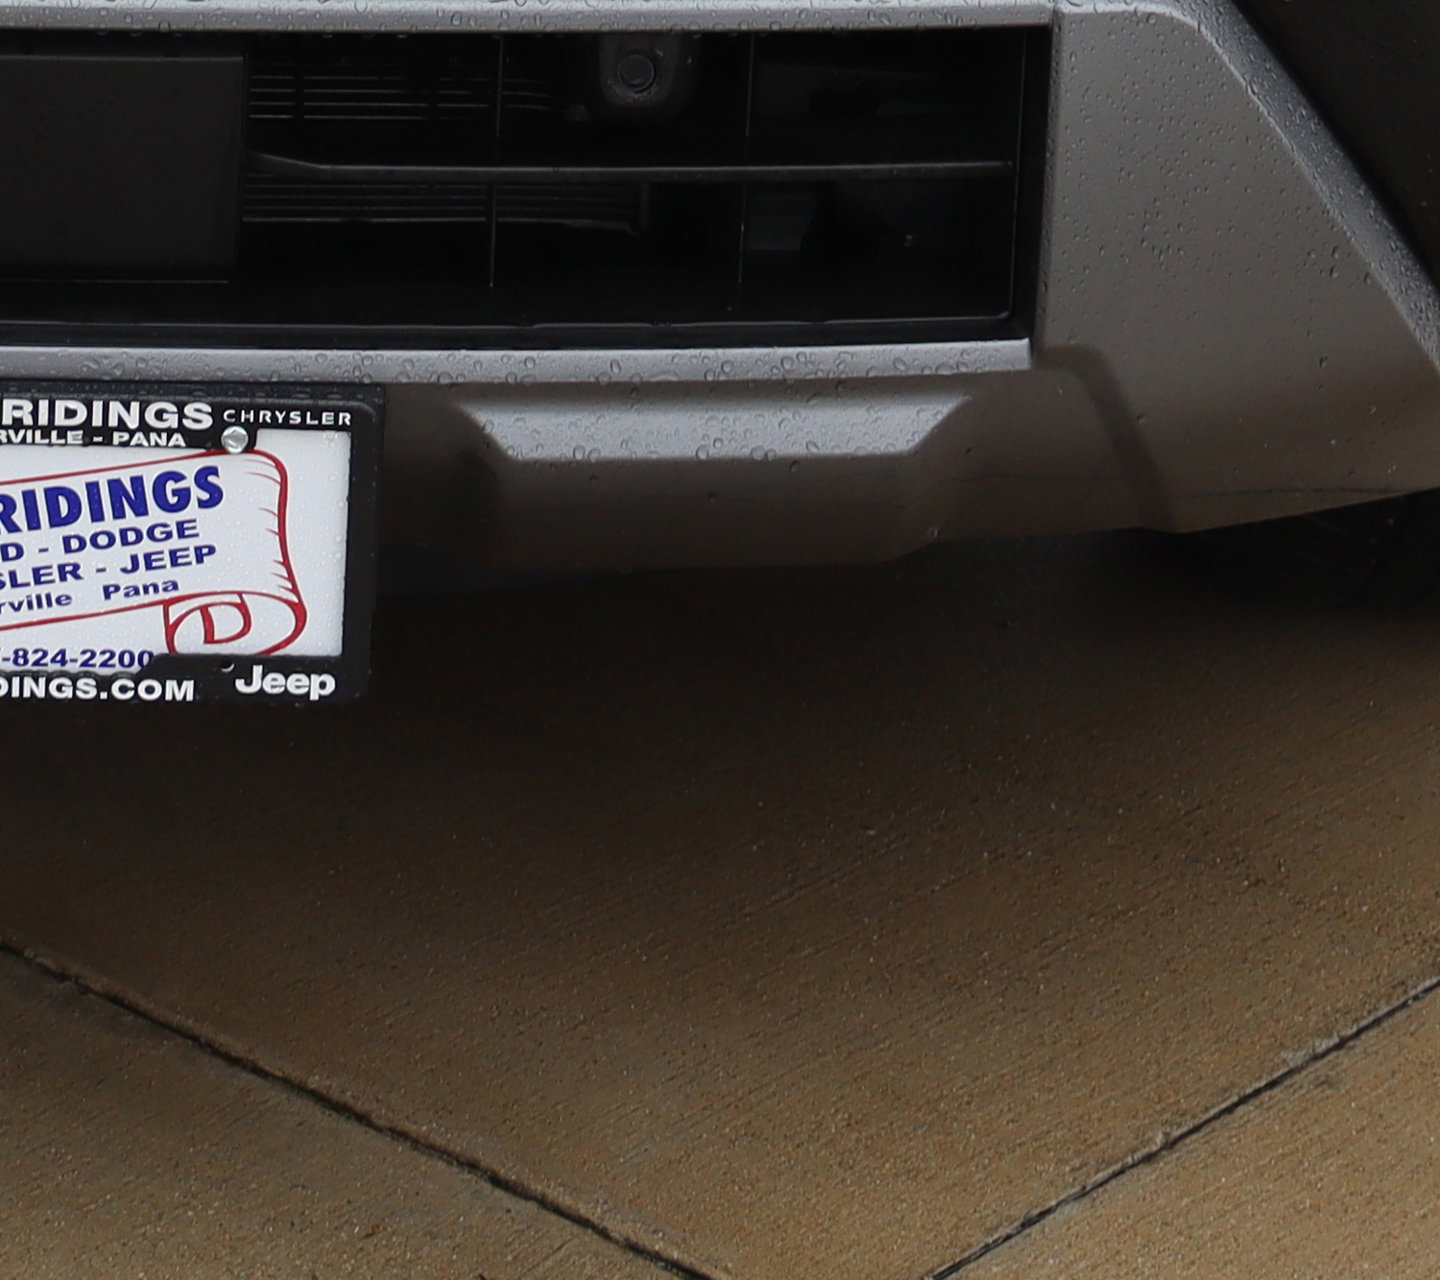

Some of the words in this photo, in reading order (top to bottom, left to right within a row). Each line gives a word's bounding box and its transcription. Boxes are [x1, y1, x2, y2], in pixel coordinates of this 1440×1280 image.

[1, 398, 214, 431] RIDINGS
[223, 409, 352, 427] CHRYSLER
[112, 430, 187, 448] PANA
[62, 518, 201, 555] DODGE
[119, 544, 217, 575] JEEP
[102, 579, 180, 601] Pana
[235, 664, 337, 700] Jeep
